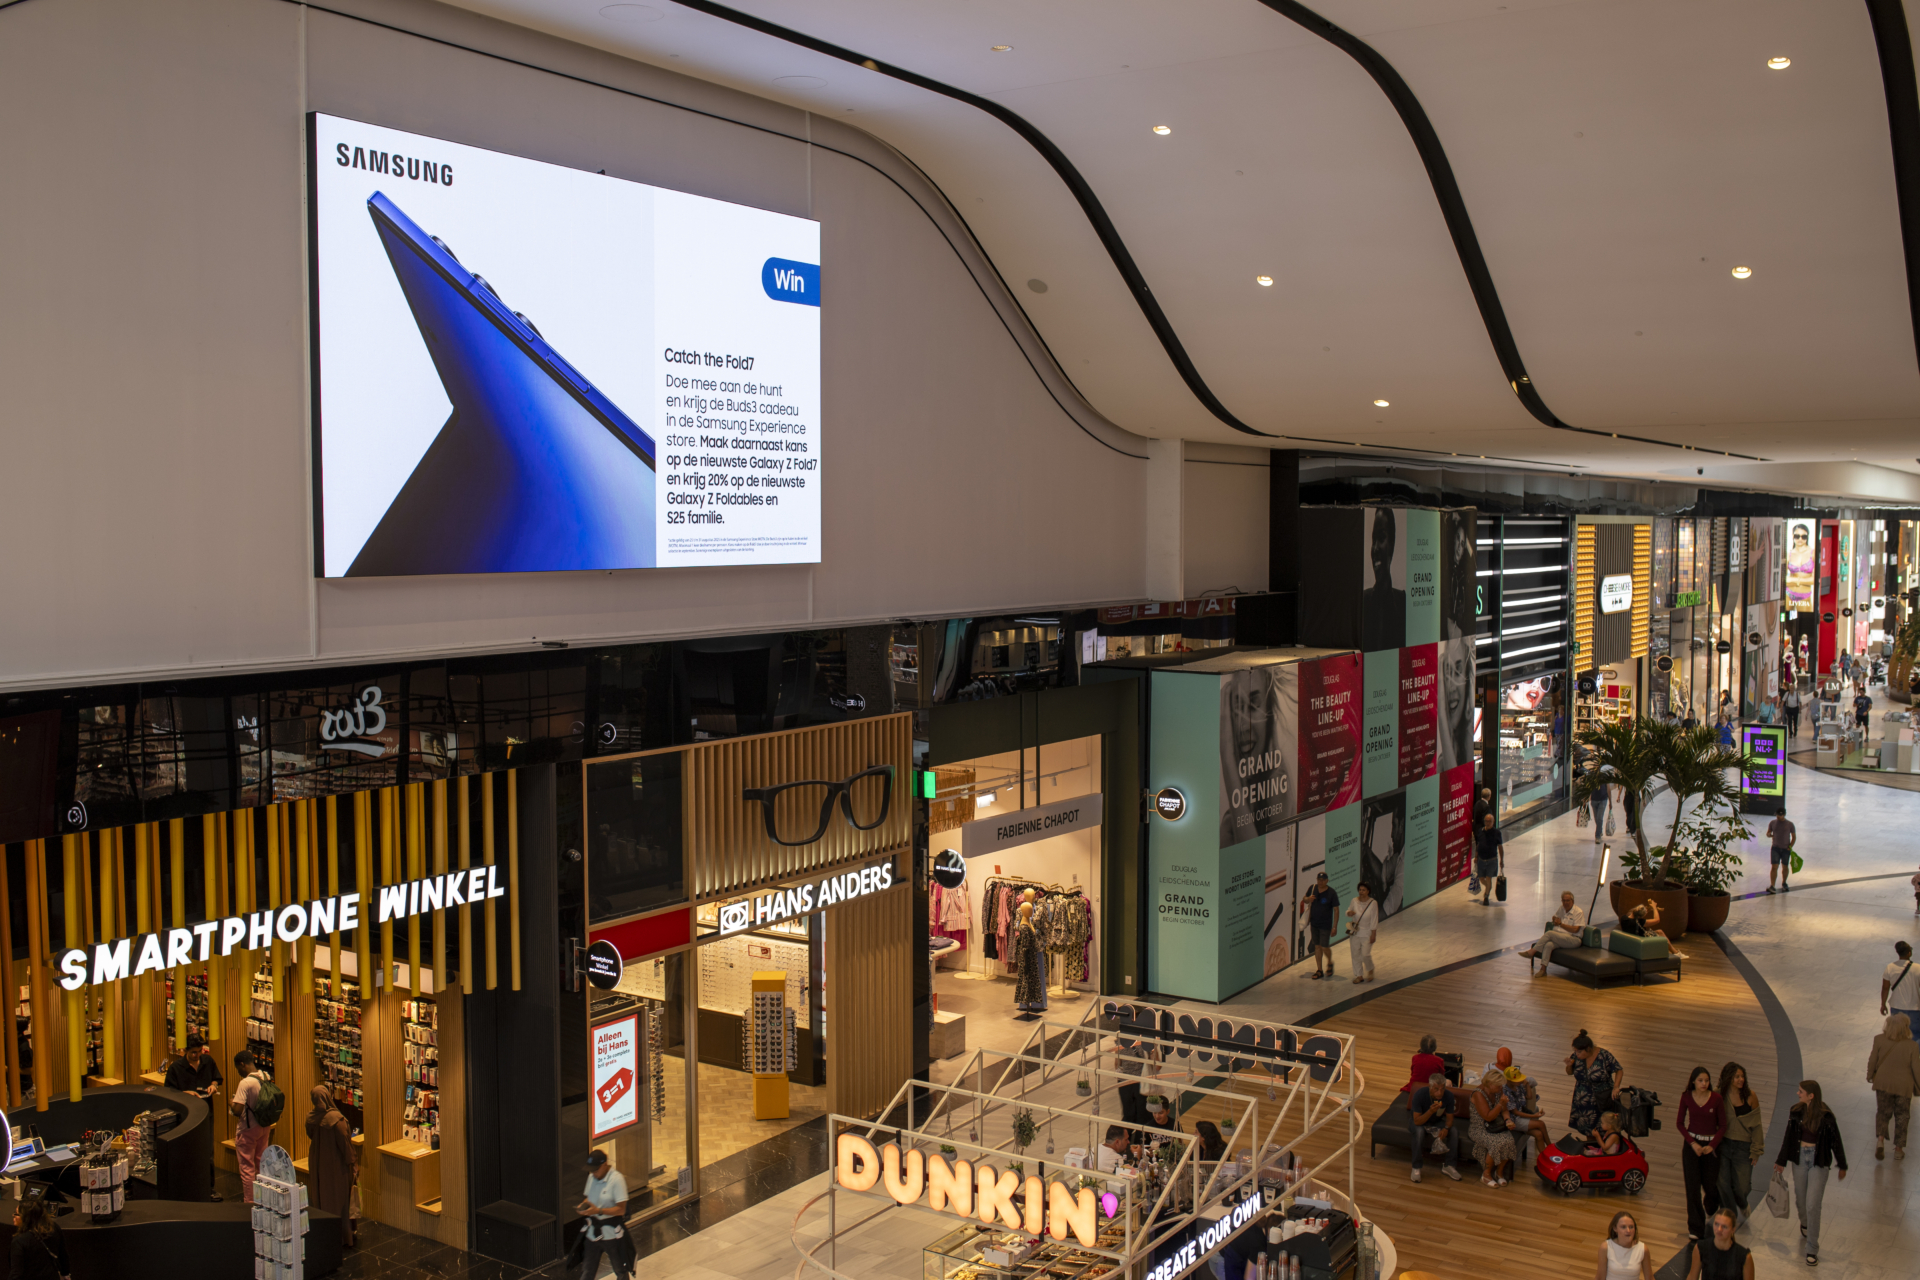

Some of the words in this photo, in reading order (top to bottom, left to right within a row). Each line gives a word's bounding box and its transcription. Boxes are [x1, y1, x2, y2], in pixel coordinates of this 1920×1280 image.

[336, 142, 453, 187] SAMSUNG
[773, 267, 805, 293] Win
[664, 347, 701, 365] Catch
[704, 352, 723, 368] the
[726, 354, 755, 371] Fold7
[666, 373, 689, 389] Doe
[691, 378, 717, 391] mee
[719, 380, 741, 393] aan
[743, 381, 757, 394] de
[759, 383, 783, 397] hunt
[666, 396, 681, 408] en
[683, 395, 707, 414] krijg
[709, 397, 724, 411] de
[726, 398, 757, 413] Buds3
[759, 402, 799, 416] cadeau
[666, 413, 676, 426] in
[678, 414, 694, 428] de
[696, 415, 747, 435] Samsung
[749, 419, 806, 436] Experience
[666, 434, 698, 448] store.
[700, 435, 729, 449] Maak
[731, 437, 783, 451] daarnaast
[785, 439, 808, 452] kans
[666, 455, 681, 470] op
[683, 453, 698, 466] de
[700, 453, 747, 468] nieuwste
[749, 456, 784, 473] Galaxy
[786, 458, 792, 470] Z
[793, 458, 818, 471] Fold7
[666, 474, 681, 485] en
[683, 472, 706, 490] krijg
[708, 473, 729, 487] 20%
[730, 476, 744, 490] op
[746, 474, 760, 487] de
[761, 476, 806, 488] nieuwste
[667, 491, 705, 509] Galaxy
[707, 492, 714, 505] Z
[716, 492, 764, 506] Foldables
[765, 495, 779, 506] en
[667, 511, 685, 524] S25
[687, 510, 725, 524] familie.
[1413, 572, 1433, 583] GRAND
[1410, 585, 1435, 597] OPENING
[1402, 678, 1413, 690] THE
[1414, 674, 1435, 688] BEAUTY
[1825, 682, 1840, 691] LM
[1311, 696, 1324, 710] THE
[1326, 690, 1352, 708] BEAUTY
[1407, 689, 1430, 704] LINE-UP
[1317, 708, 1345, 726] LINE-UP
[1369, 723, 1391, 738] GRAND
[1365, 737, 1393, 754] OPENING
[1238, 749, 1282, 779] GRAND
[1231, 774, 1288, 809] OPENING
[1159, 802, 1181, 810] CHAPOT
[1442, 801, 1452, 813] THE
[1452, 793, 1469, 809] BEAUTY
[1236, 811, 1255, 828] BEGIN
[1255, 802, 1283, 822] OKTOBER
[1446, 808, 1465, 824] LINE-UP
[997, 818, 1042, 841] FABIENNE
[1044, 808, 1080, 829] CHAPOT
[1171, 865, 1198, 873] DOUGLAS
[1158, 876, 1211, 888] LEIDSCHENDAM
[755, 883, 813, 926] HANS
[817, 862, 893, 909] ANDERS
[1164, 893, 1205, 905] GRAND
[1158, 904, 1210, 918] OPENING
[57, 891, 361, 992] SMARTPHONE
[377, 864, 505, 923] WINKEL
[1179, 917, 1205, 926] OKTOBER
[597, 1031, 622, 1045] Alleen
[597, 1044, 608, 1055] bij
[609, 1039, 629, 1052] Hans
[602, 1077, 625, 1103] 3=1
[836, 1132, 1119, 1249] DUNKIN'
[1198, 1214, 1231, 1255] YOUR
[1232, 1190, 1261, 1228] OWN
